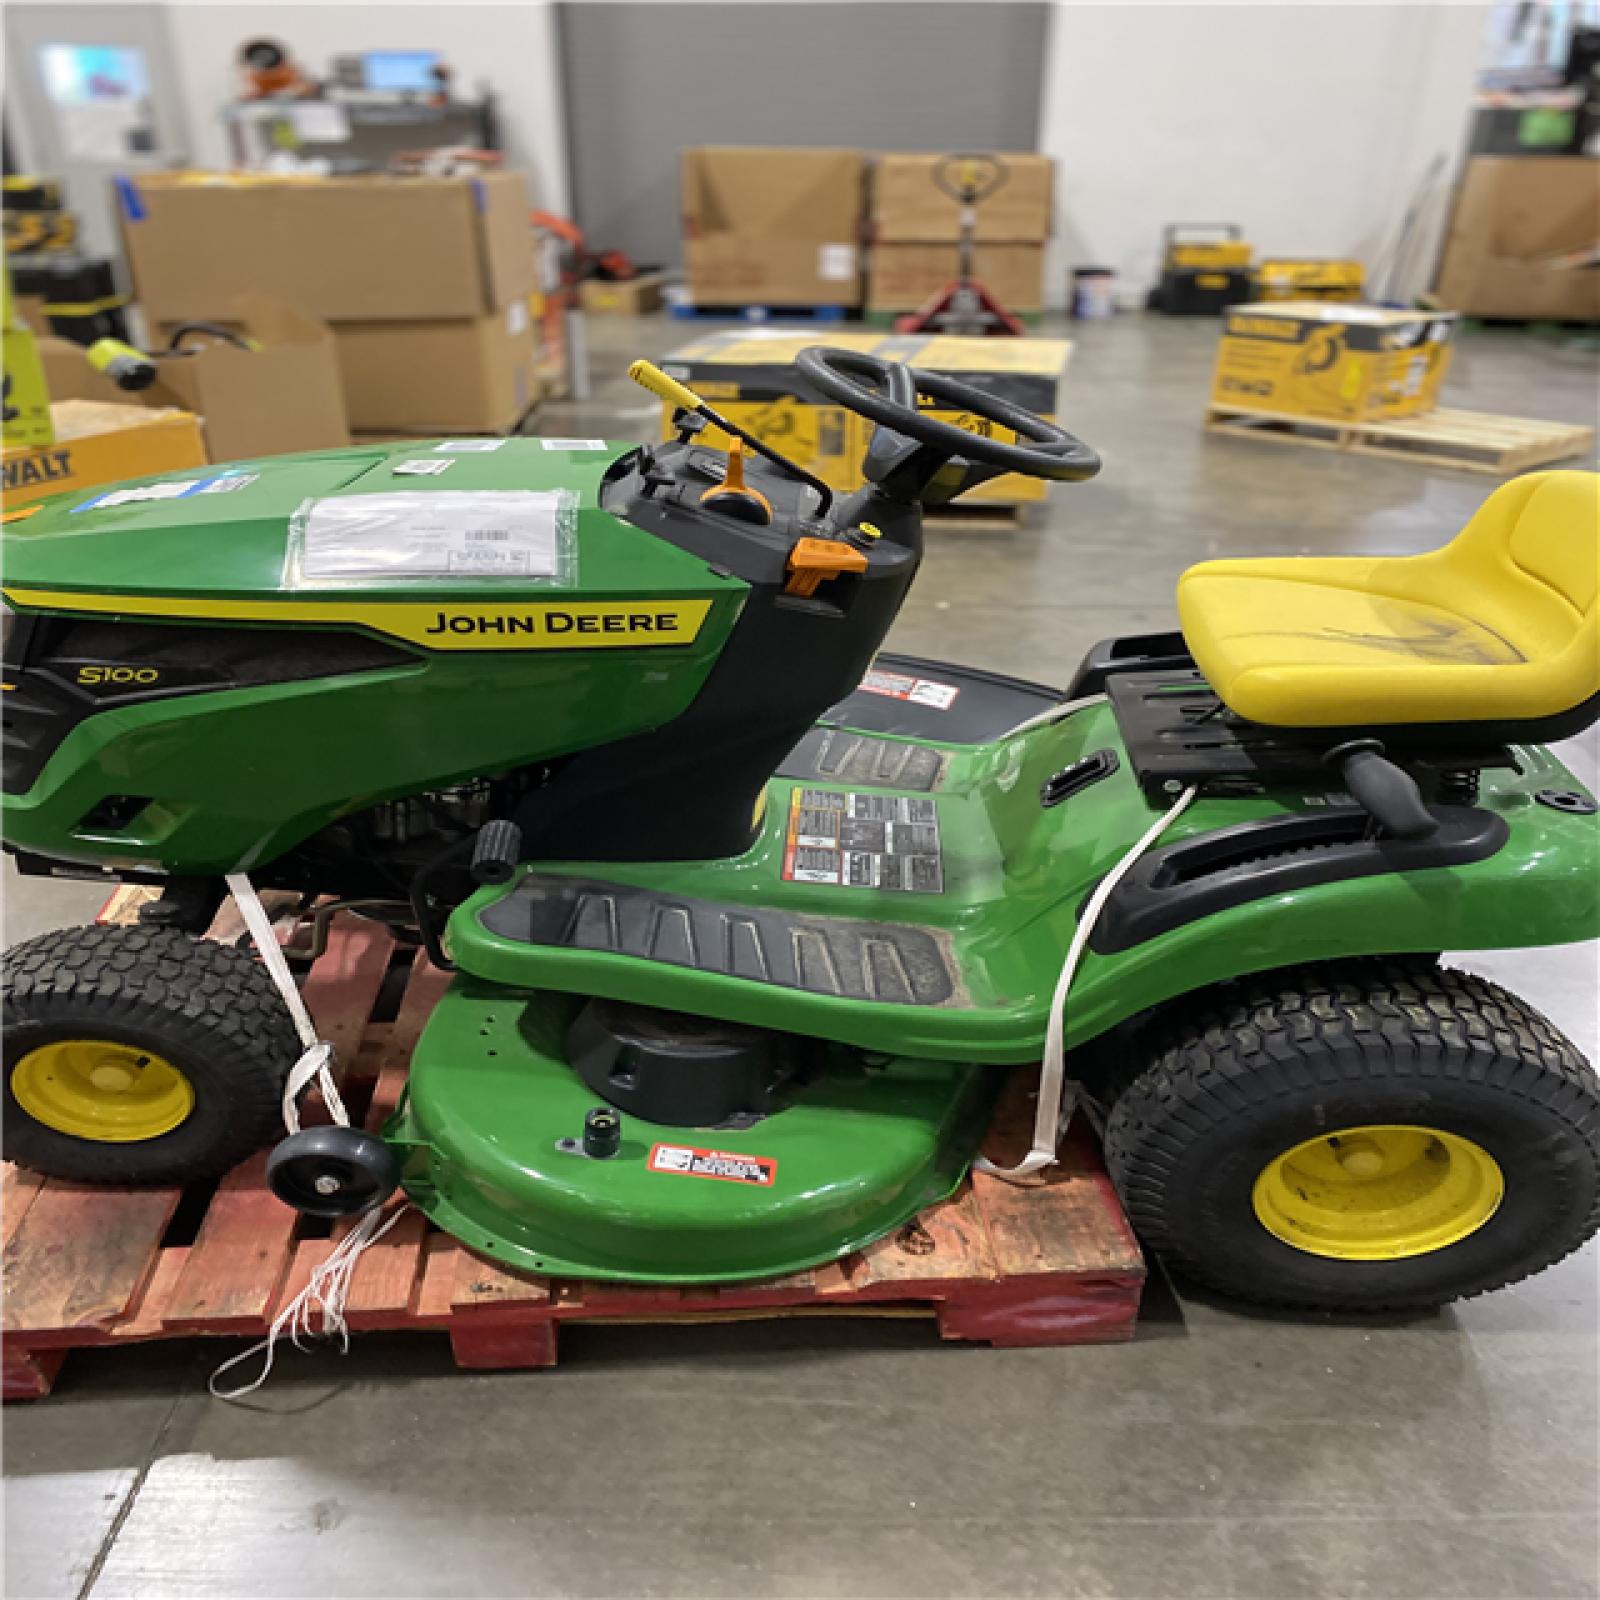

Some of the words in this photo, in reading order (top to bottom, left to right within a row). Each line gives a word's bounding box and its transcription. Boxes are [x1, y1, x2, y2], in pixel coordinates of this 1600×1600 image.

[425, 612, 535, 634] JOHN
[545, 612, 679, 632] DEERE
[78, 666, 159, 684] S100
